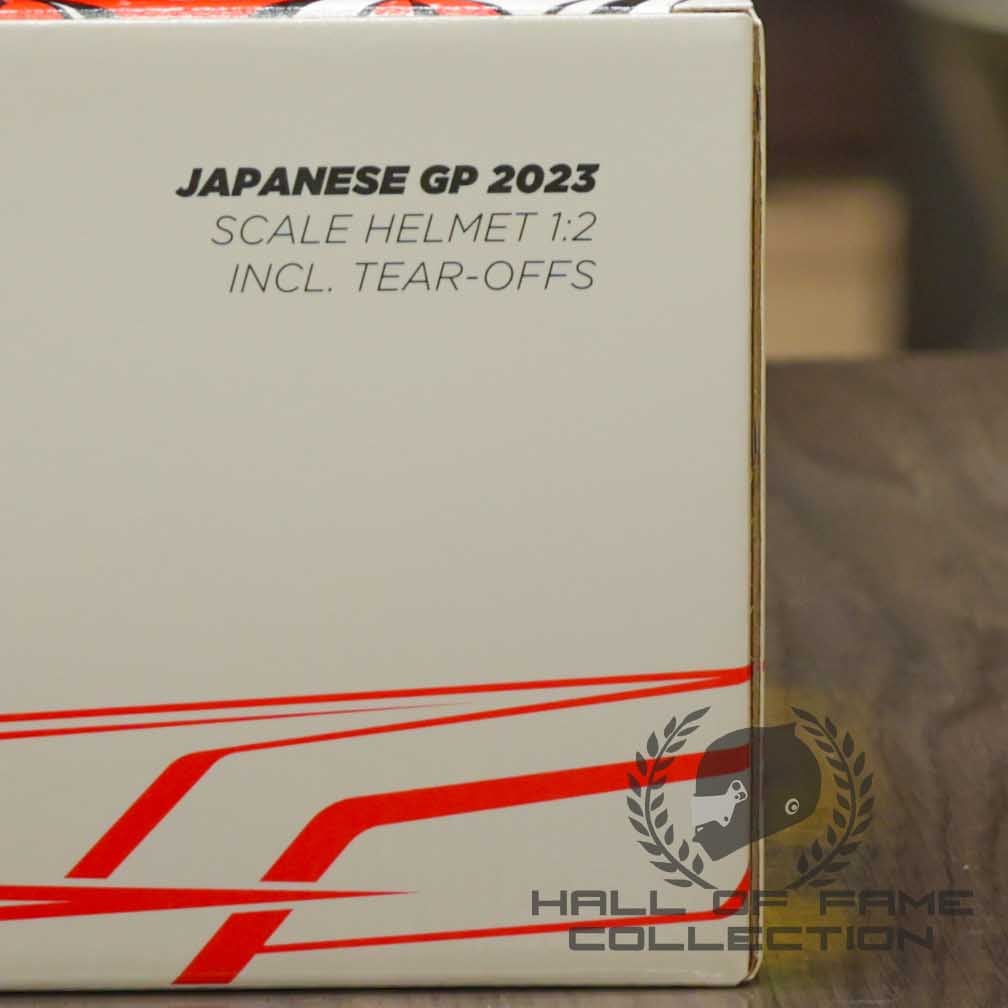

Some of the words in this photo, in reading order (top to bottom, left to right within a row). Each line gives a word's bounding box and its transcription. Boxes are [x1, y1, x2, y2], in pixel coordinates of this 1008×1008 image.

[175, 165, 411, 198] JAPANESE
[419, 164, 479, 195] GP
[487, 163, 600, 195] 2023
[210, 214, 354, 245] SCALE
[364, 211, 539, 244] HELMET
[550, 211, 598, 242] 1:2
[228, 263, 334, 294] INCL.
[355, 260, 598, 292] TEAR-OFFS
